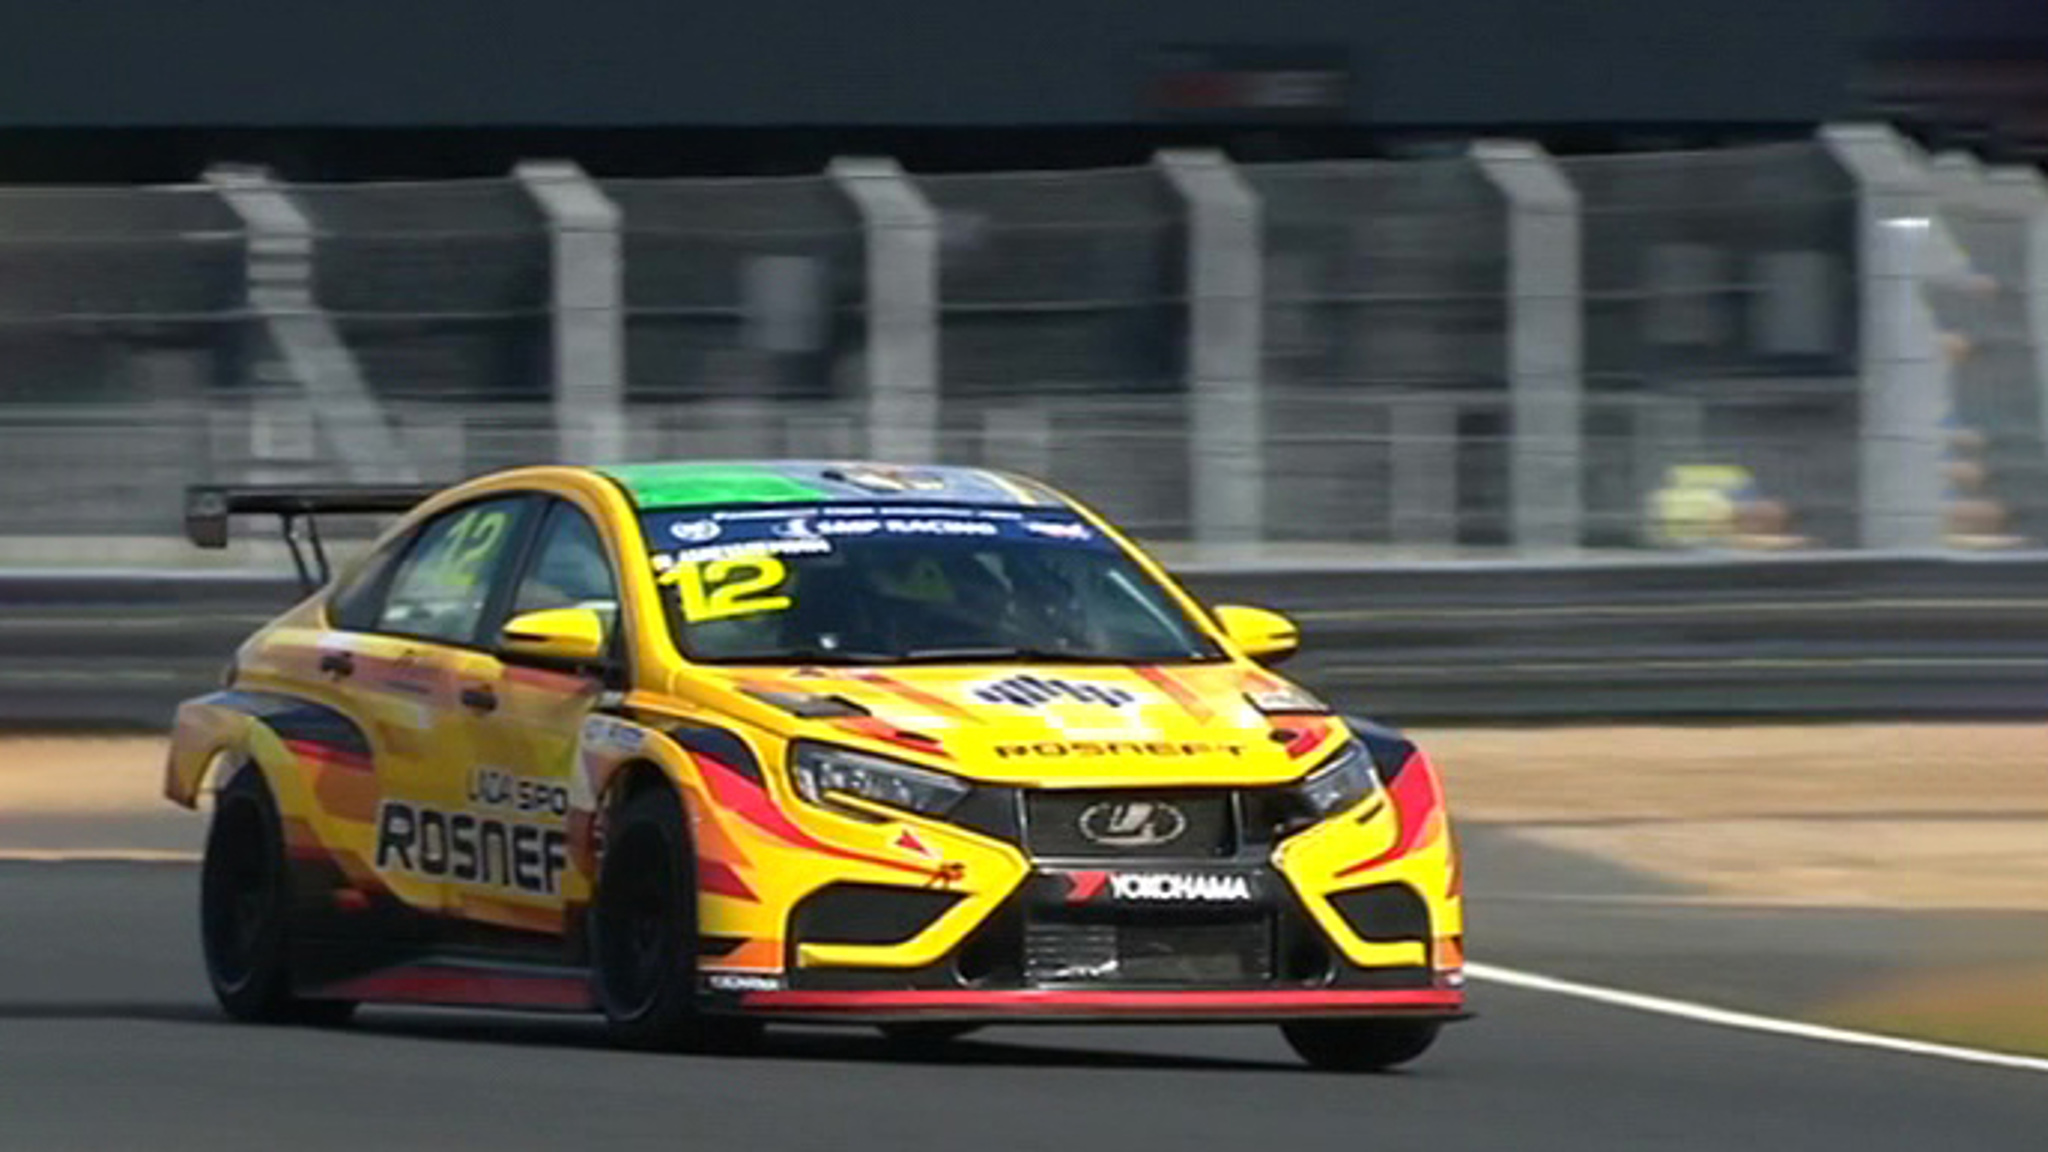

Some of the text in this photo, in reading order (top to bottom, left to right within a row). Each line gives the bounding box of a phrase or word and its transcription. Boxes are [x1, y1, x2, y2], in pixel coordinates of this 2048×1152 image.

[445, 512, 505, 585] 12
[658, 553, 792, 621] 12
[1110, 873, 1251, 900] YOKOHAMA
